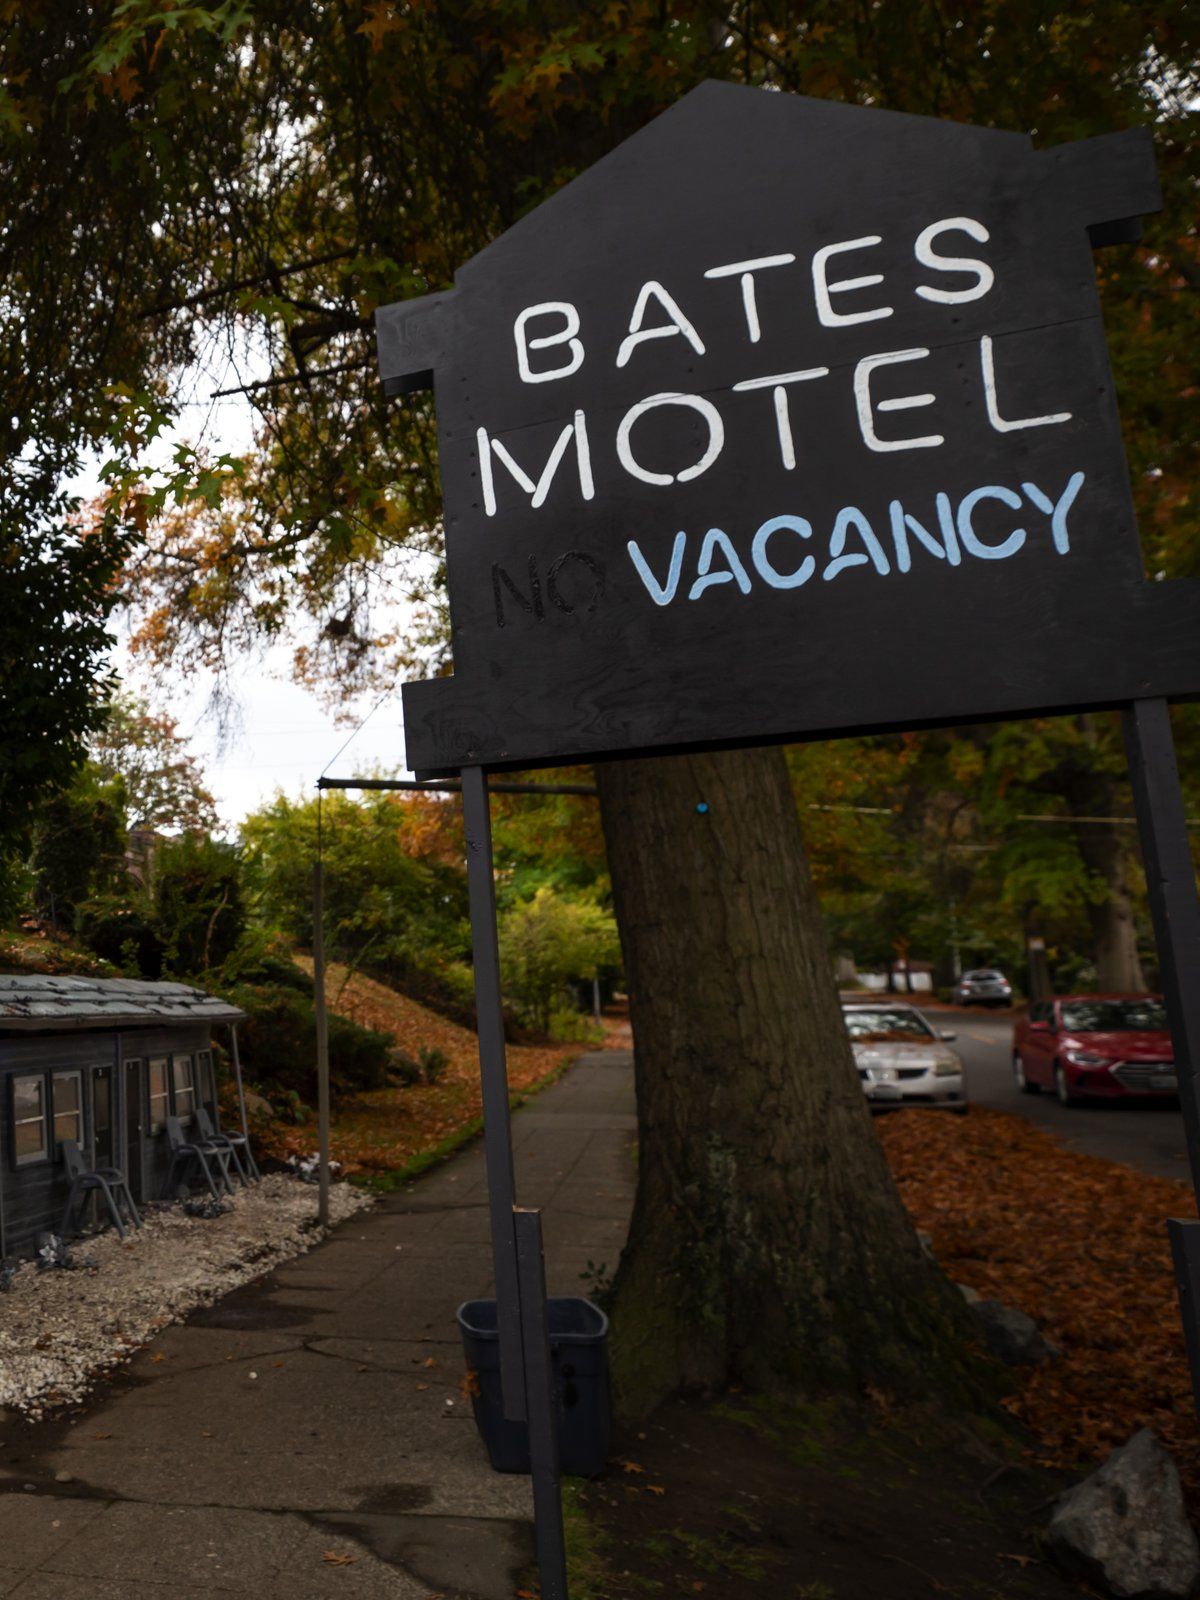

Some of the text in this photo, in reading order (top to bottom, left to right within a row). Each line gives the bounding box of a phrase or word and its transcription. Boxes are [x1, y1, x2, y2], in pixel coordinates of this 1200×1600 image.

[513, 216, 995, 384] BATES
[476, 334, 1073, 517] MOTEL
[491, 471, 1085, 628] NO VACANCY
